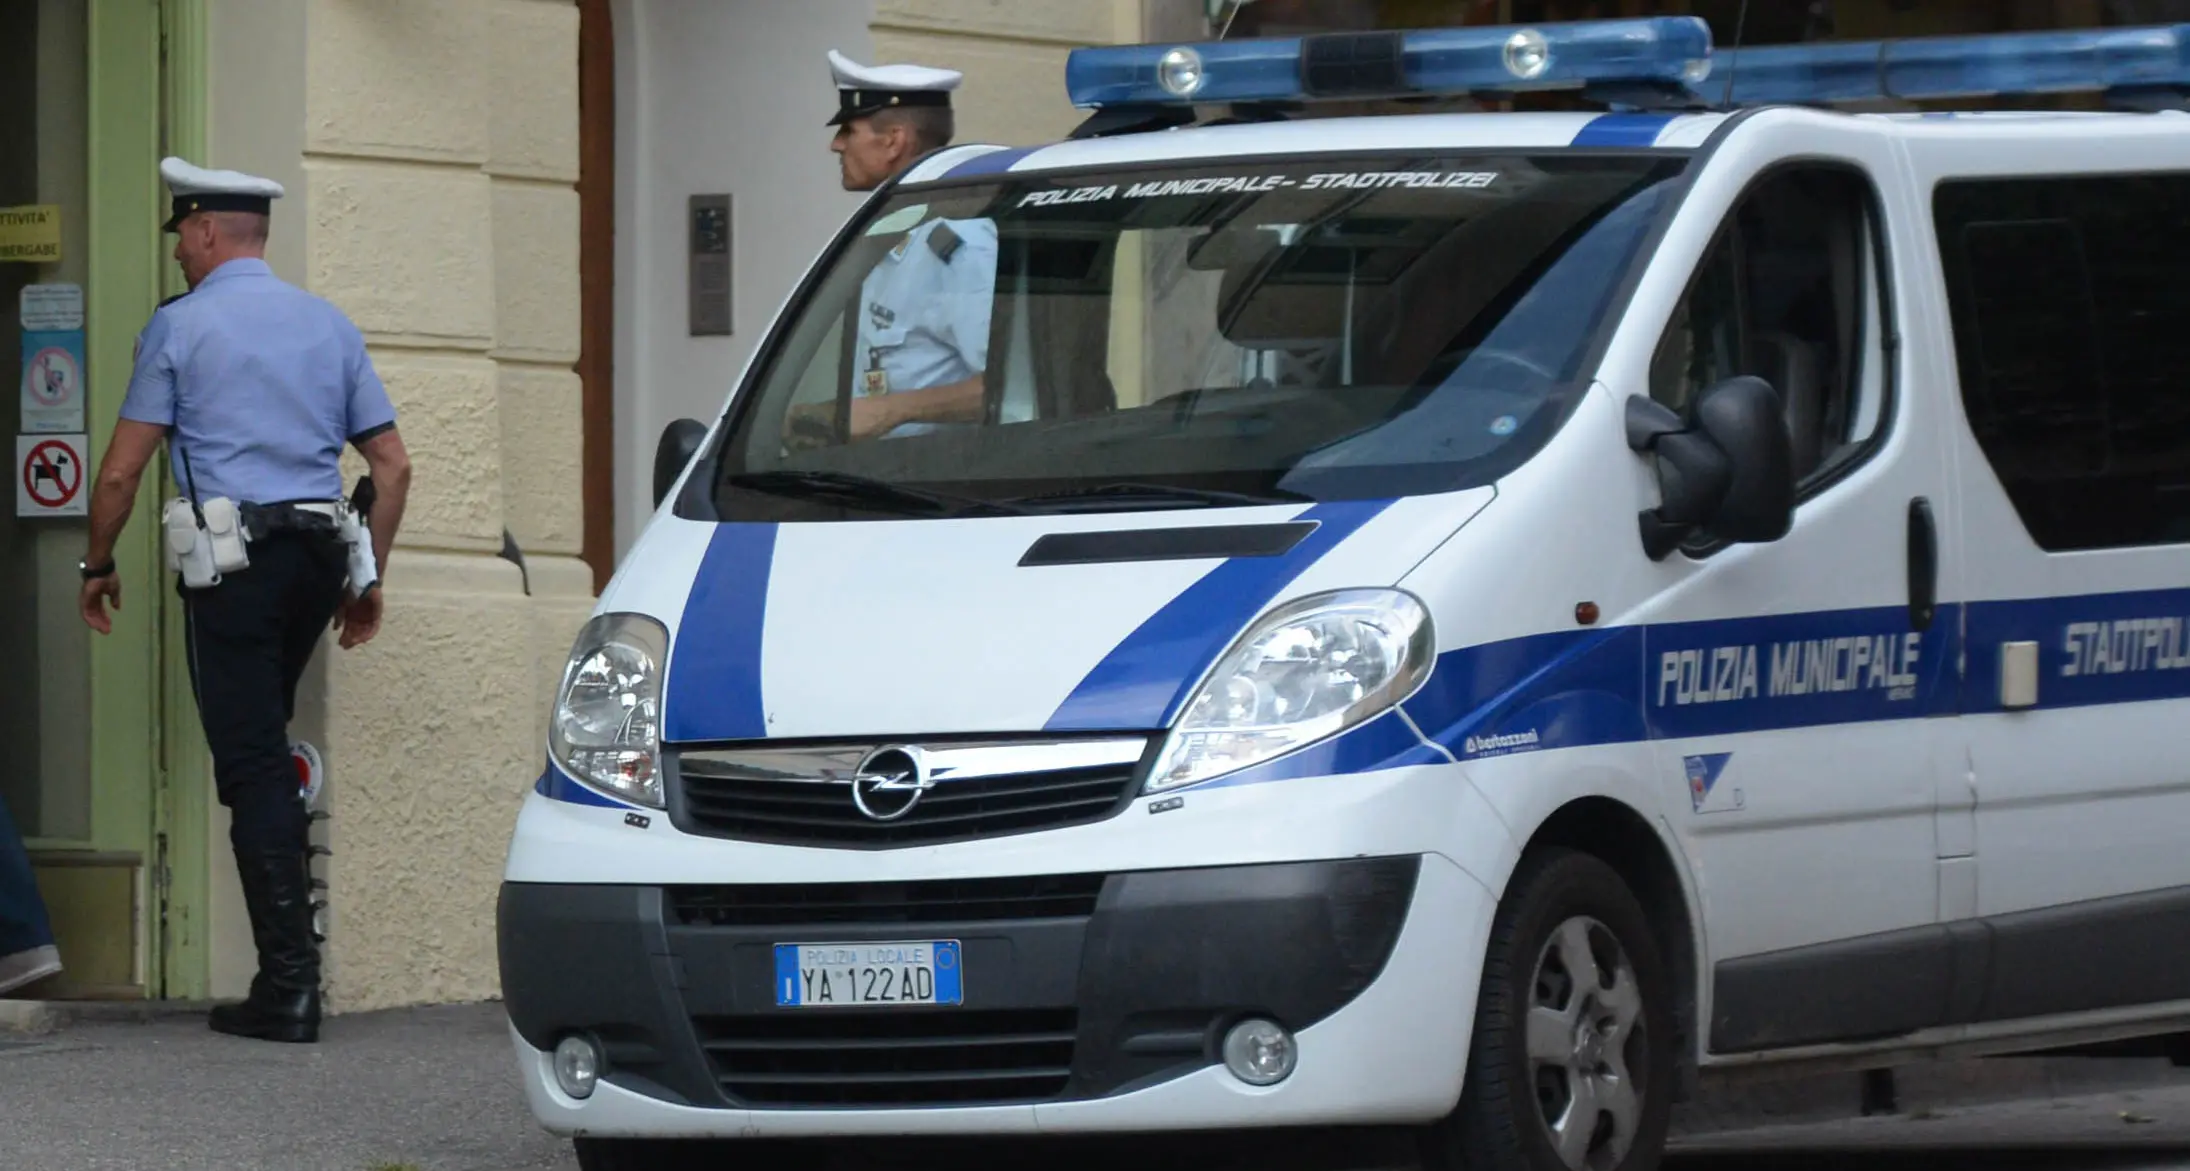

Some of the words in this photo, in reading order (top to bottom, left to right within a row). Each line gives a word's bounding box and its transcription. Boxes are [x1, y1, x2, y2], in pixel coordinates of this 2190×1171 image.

[1017, 185, 1117, 208] POLIZIA
[1299, 172, 1498, 189] STADTPOLIZEI
[0, 243, 57, 257] BERGABE
[1658, 645, 1758, 707] POLIZIA
[1770, 632, 1920, 697] MUNICIPALE
[807, 949, 857, 965] POLIZIA
[867, 948, 925, 964] LOCALE
